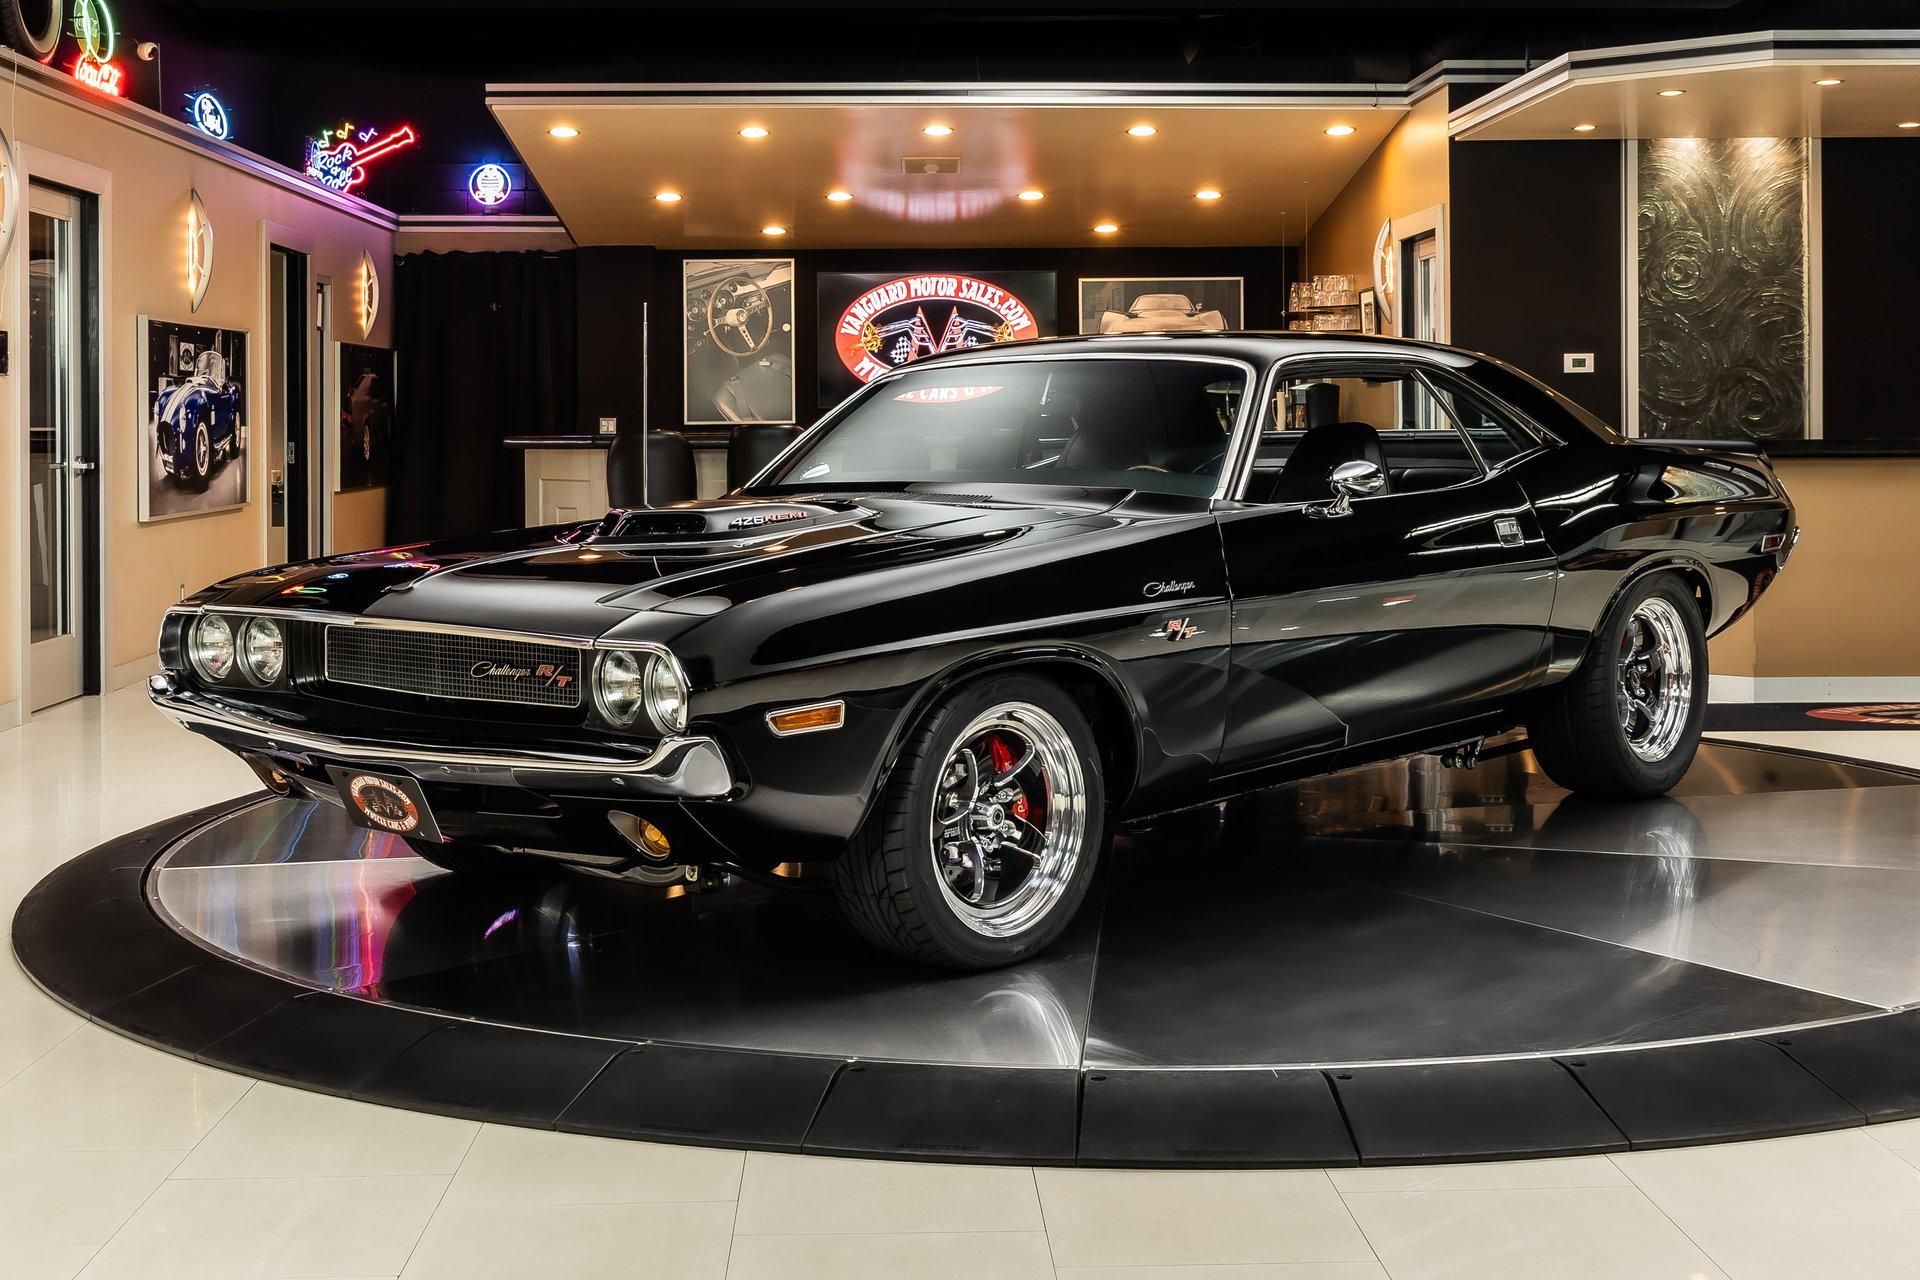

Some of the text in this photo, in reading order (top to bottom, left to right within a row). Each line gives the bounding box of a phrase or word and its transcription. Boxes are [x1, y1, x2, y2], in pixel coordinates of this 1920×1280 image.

[317, 145, 353, 171] Rock
[840, 276, 1032, 336] VANGUARD MOTOR SALES.COM
[1143, 580, 1196, 598] Challenger
[1167, 617, 1198, 641] R/T
[470, 660, 573, 688] Challenger R/T
